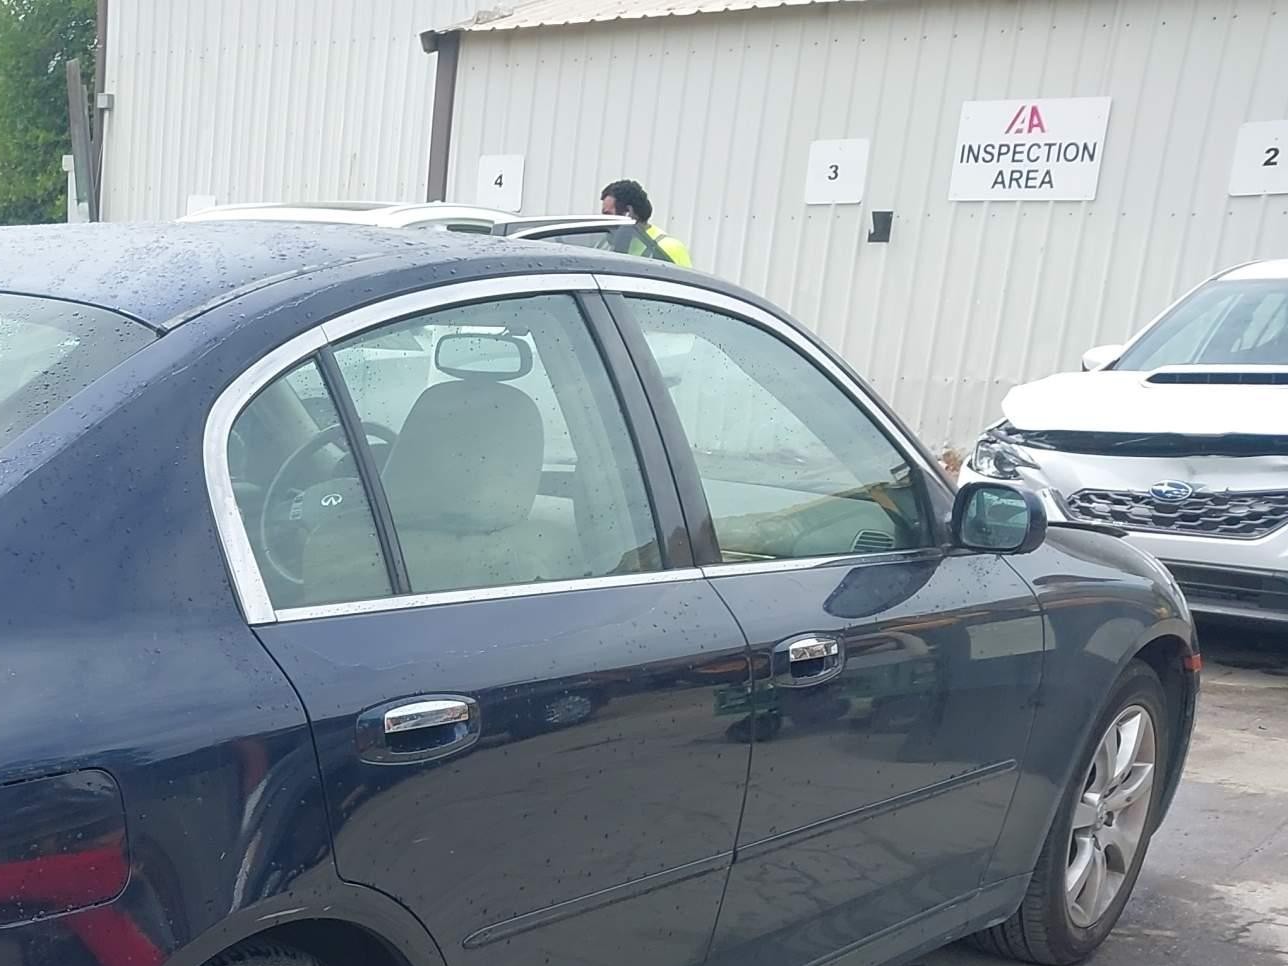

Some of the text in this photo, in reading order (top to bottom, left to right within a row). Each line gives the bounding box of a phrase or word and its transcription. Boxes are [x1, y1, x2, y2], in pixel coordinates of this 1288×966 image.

[960, 142, 1097, 163] INSPECTION
[1262, 147, 1280, 166] 2
[494, 173, 504, 189] 4
[828, 165, 840, 182] 3
[991, 169, 1054, 189] AREA
